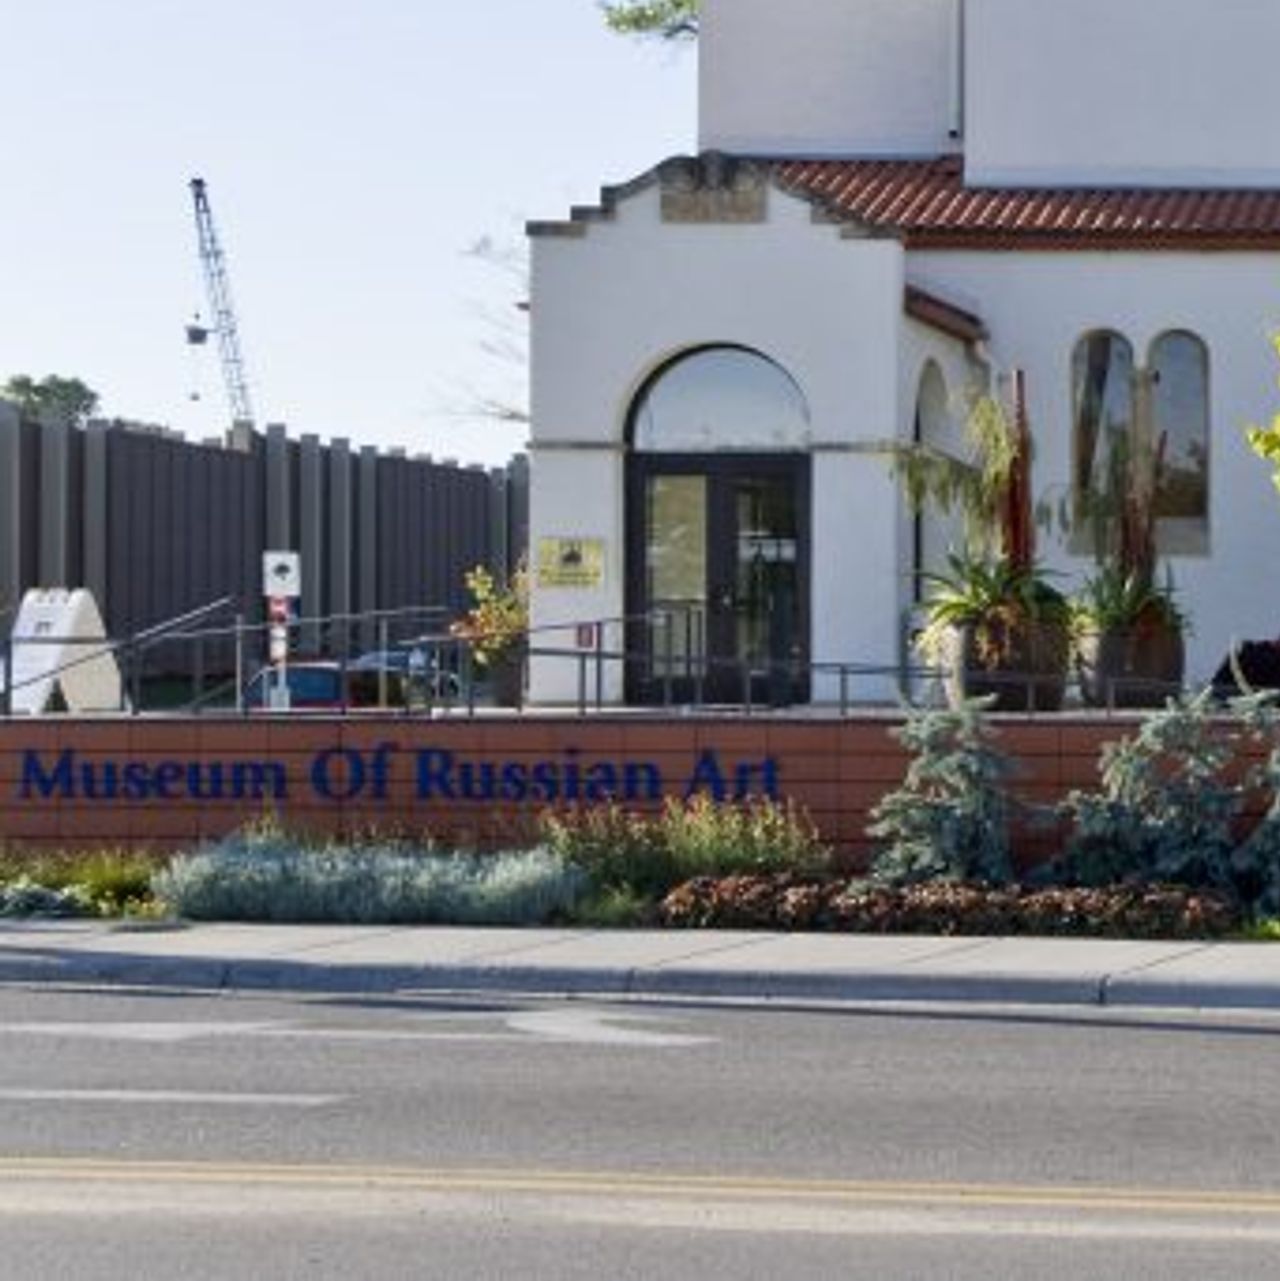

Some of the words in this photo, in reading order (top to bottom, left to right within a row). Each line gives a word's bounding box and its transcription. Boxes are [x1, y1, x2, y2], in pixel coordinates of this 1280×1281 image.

[18, 748, 288, 799] Museum
[310, 741, 399, 800] Of
[415, 746, 662, 799] Russian
[683, 748, 782, 800] Art
